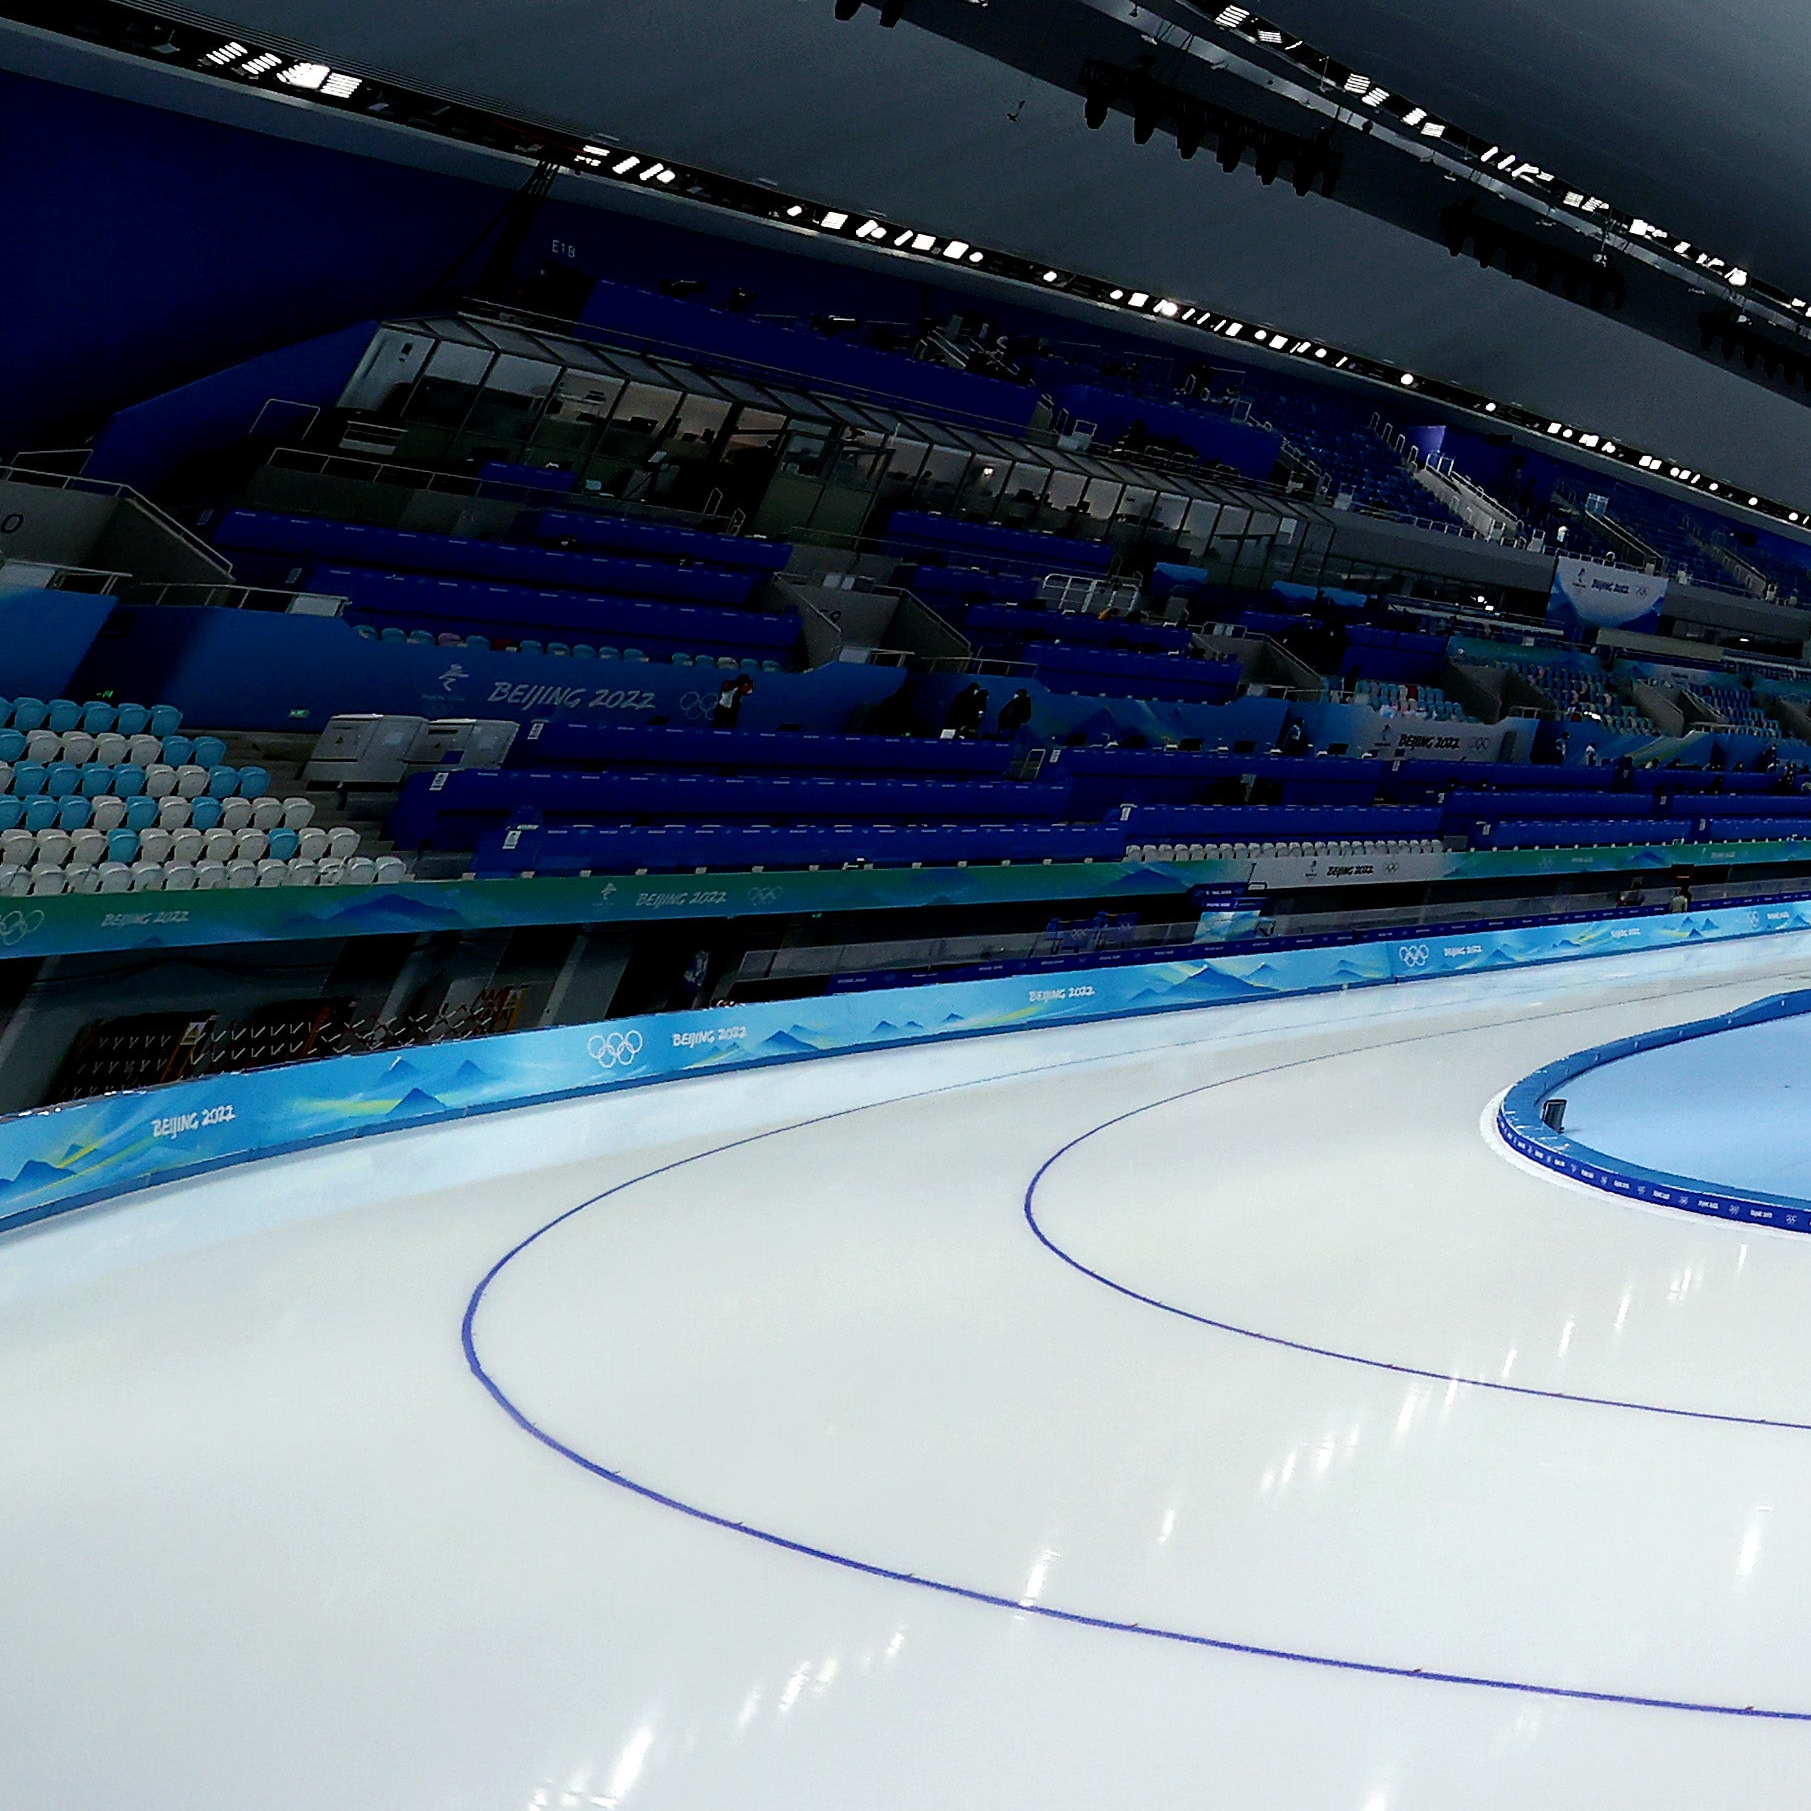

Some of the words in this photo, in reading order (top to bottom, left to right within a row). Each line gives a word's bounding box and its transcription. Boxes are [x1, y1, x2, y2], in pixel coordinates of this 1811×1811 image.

[489, 682, 587, 711] BEIJING
[590, 690, 656, 710] 2022
[1399, 735, 1434, 751] BEIJING
[1436, 737, 1459, 750] 2022
[1327, 867, 1353, 878] BEIJING
[1355, 866, 1374, 875] 2022
[636, 893, 687, 908] BEIJING
[689, 892, 726, 904] 2022
[102, 913, 152, 927] BEIJING
[154, 911, 189, 924] 2022
[1029, 989, 1066, 1003] BEIJING
[1069, 987, 1095, 998] 2022
[673, 1031, 715, 1049] BEIJING
[718, 1027, 747, 1039] 2022
[151, 1112, 199, 1140] BEIJING
[202, 1105, 236, 1127] 2022
